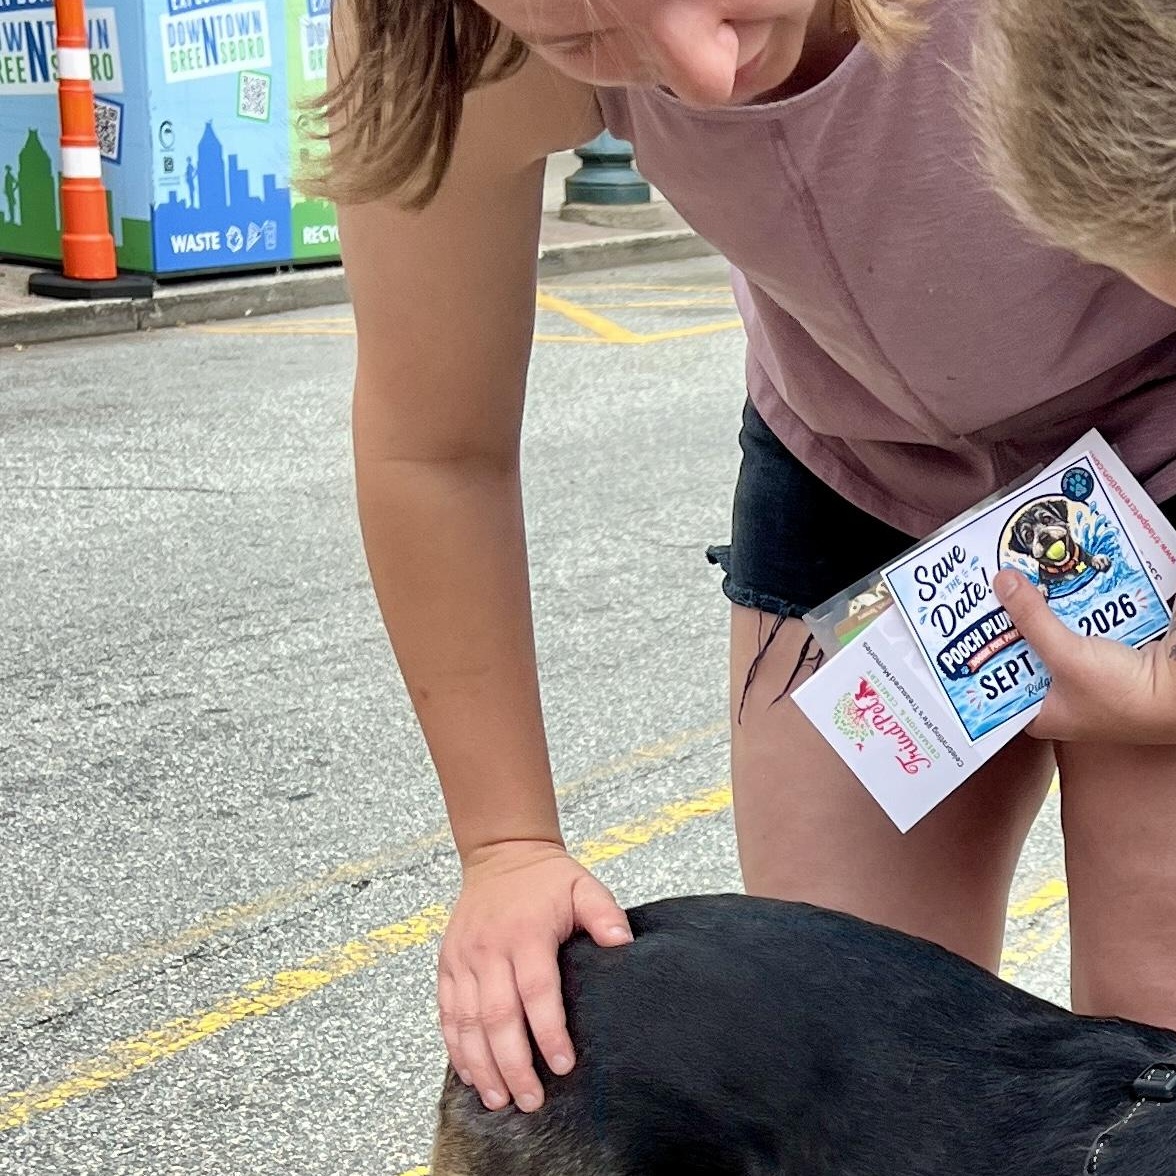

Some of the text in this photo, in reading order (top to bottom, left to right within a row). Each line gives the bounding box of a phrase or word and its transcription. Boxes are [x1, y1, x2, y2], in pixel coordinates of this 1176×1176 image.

[166, 10, 262, 48] DOWNTOWN
[169, 37, 265, 74] GREENSBORO
[170, 231, 221, 253] WASTE
[303, 225, 340, 244] RECY
[914, 545, 966, 601] Save
[945, 576, 963, 594] THE
[931, 567, 993, 637] Date!
[862, 641, 892, 678] Memories
[940, 628, 985, 675] POOCH
[979, 593, 1137, 700] SEPT 2026
[890, 676, 920, 713] Treasured
[1025, 677, 1053, 698] Ridg
[931, 725, 965, 768] Celebrating
